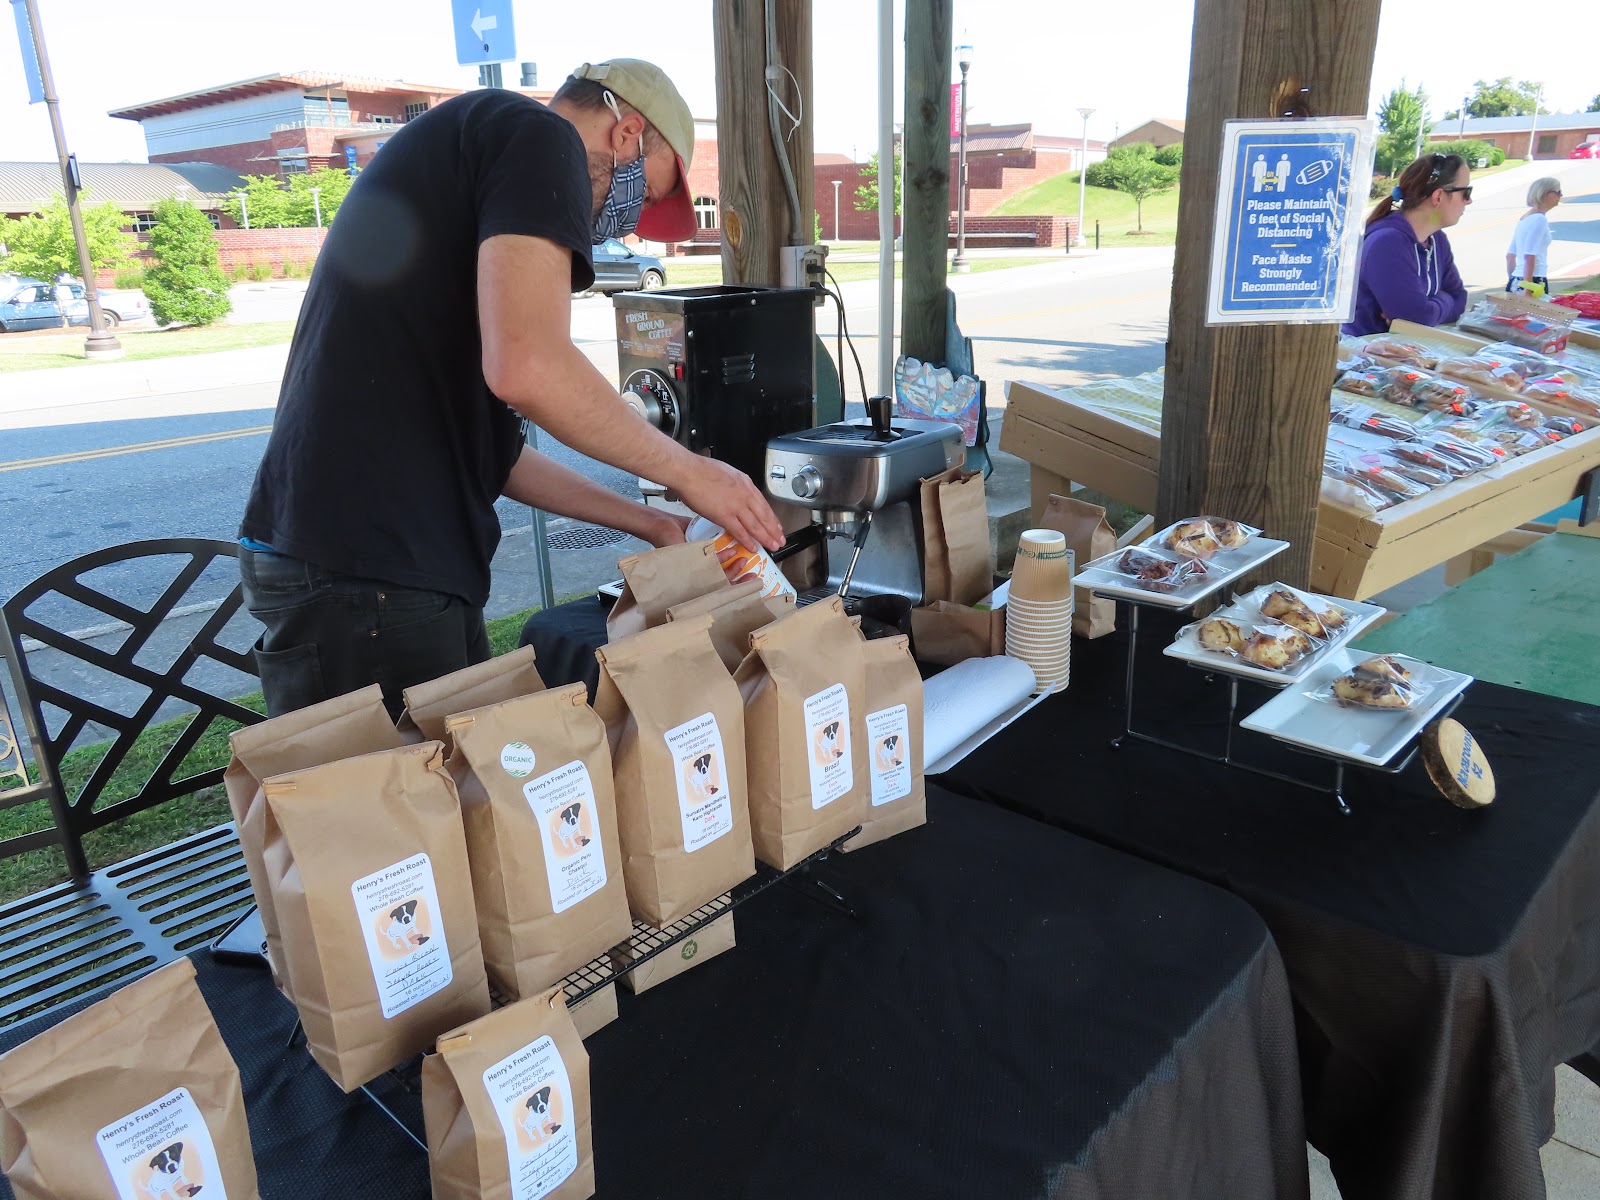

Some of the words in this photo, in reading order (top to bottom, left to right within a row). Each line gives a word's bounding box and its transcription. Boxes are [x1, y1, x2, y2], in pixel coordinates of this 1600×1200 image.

[1264, 184, 1274, 192] 2m
[1247, 200, 1281, 211] Please
[1284, 198, 1332, 210] Maintain
[1249, 213, 1257, 224] 6
[1259, 213, 1279, 225] feet
[1281, 213, 1290, 224] of
[1292, 212, 1325, 224] Social
[1257, 227, 1313, 239] Distancing
[1252, 255, 1277, 265] Face
[1279, 254, 1313, 264] Masks
[1259, 268, 1302, 279] Strongly
[1241, 281, 1318, 292] Recommended
[625, 311, 648, 323] FRESH
[637, 319, 665, 332] GROUND
[648, 327, 673, 340] COFFEE
[668, 731, 688, 743] Henry's
[687, 724, 702, 734] Fresh
[700, 718, 714, 729] Roast
[503, 755, 533, 764] ORGANIC
[824, 759, 840, 773] Brazil
[1457, 730, 1472, 789] Macaroons
[528, 780, 551, 794] Henry's
[550, 771, 568, 783] Fresh
[567, 764, 584, 776] Roast
[544, 804, 560, 815] Whole
[559, 798, 571, 807] Bean
[571, 791, 586, 802] Coffee
[704, 814, 716, 824] Dark
[561, 859, 580, 873] Organic
[580, 852, 592, 862] Peru
[356, 877, 384, 892] Henry's
[384, 867, 406, 880] Fresh
[405, 857, 427, 871] Roast
[366, 872, 423, 900] henrysfreshroast.com
[369, 901, 389, 913] Whole
[389, 893, 405, 904] Bean
[405, 885, 424, 897] Coffee
[412, 979, 432, 993] ounces
[387, 997, 410, 1013] Roasted
[410, 992, 418, 1001] on
[487, 1064, 513, 1082] Henry's
[512, 1051, 532, 1067] Fresh
[531, 1040, 551, 1055] Roast
[498, 1055, 551, 1090] henrysfreshroast.com
[504, 1089, 522, 1103] Whole
[522, 1080, 538, 1093] Bean
[537, 1069, 555, 1083] Coffee
[102, 1121, 135, 1141] Henry's
[135, 1107, 159, 1124] Fresh
[159, 1092, 184, 1110] Roast
[115, 1108, 183, 1149] henrysfreshroast.com
[131, 1120, 175, 1150] 276-692-5281
[121, 1148, 146, 1164] Whole
[146, 1136, 165, 1151] Bean
[165, 1123, 189, 1139] Coffee
